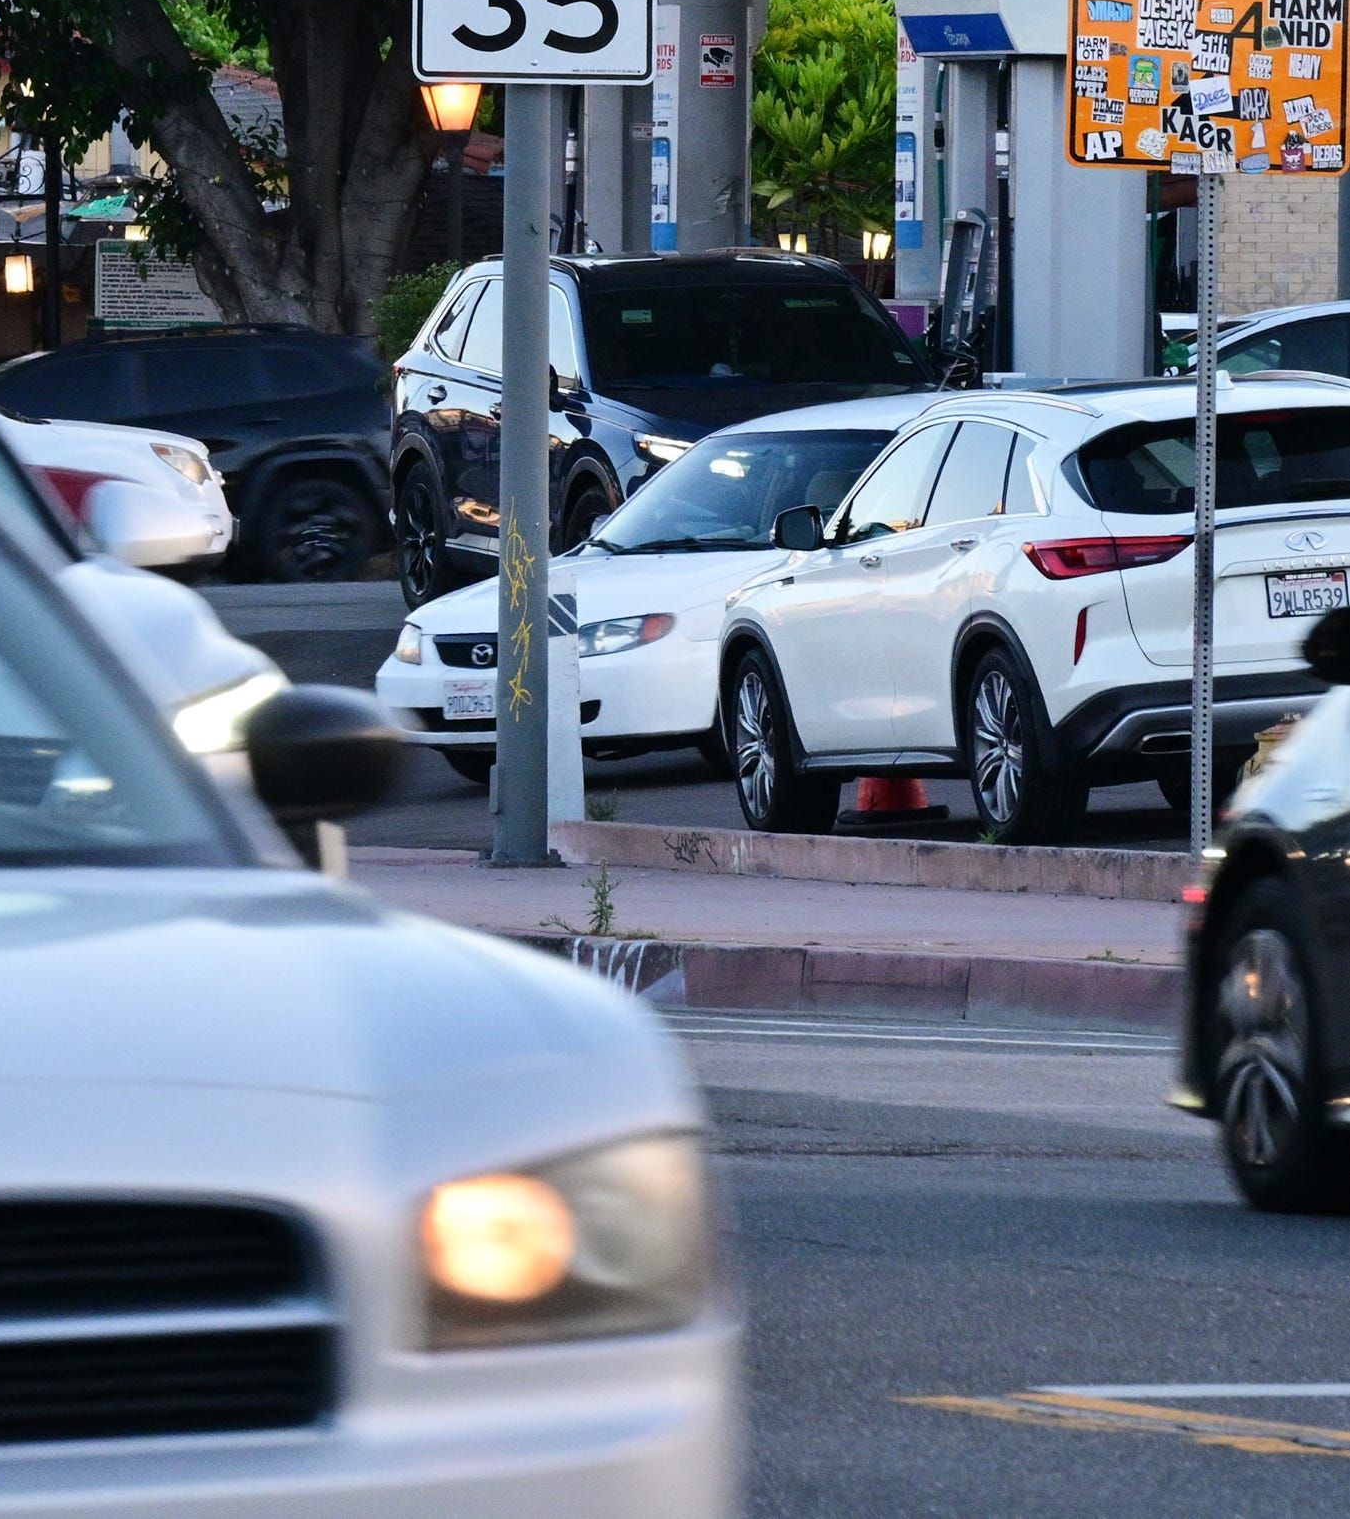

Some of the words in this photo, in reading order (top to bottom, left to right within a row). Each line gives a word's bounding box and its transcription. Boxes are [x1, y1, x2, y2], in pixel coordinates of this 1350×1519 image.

[702, 36, 733, 45] WARNING
[1078, 37, 1108, 48] HARM
[1279, 20, 1331, 47] NHD
[1083, 49, 1104, 59] OTR
[1086, 130, 1122, 160] AP
[1273, 587, 1343, 612] 9WLR539
